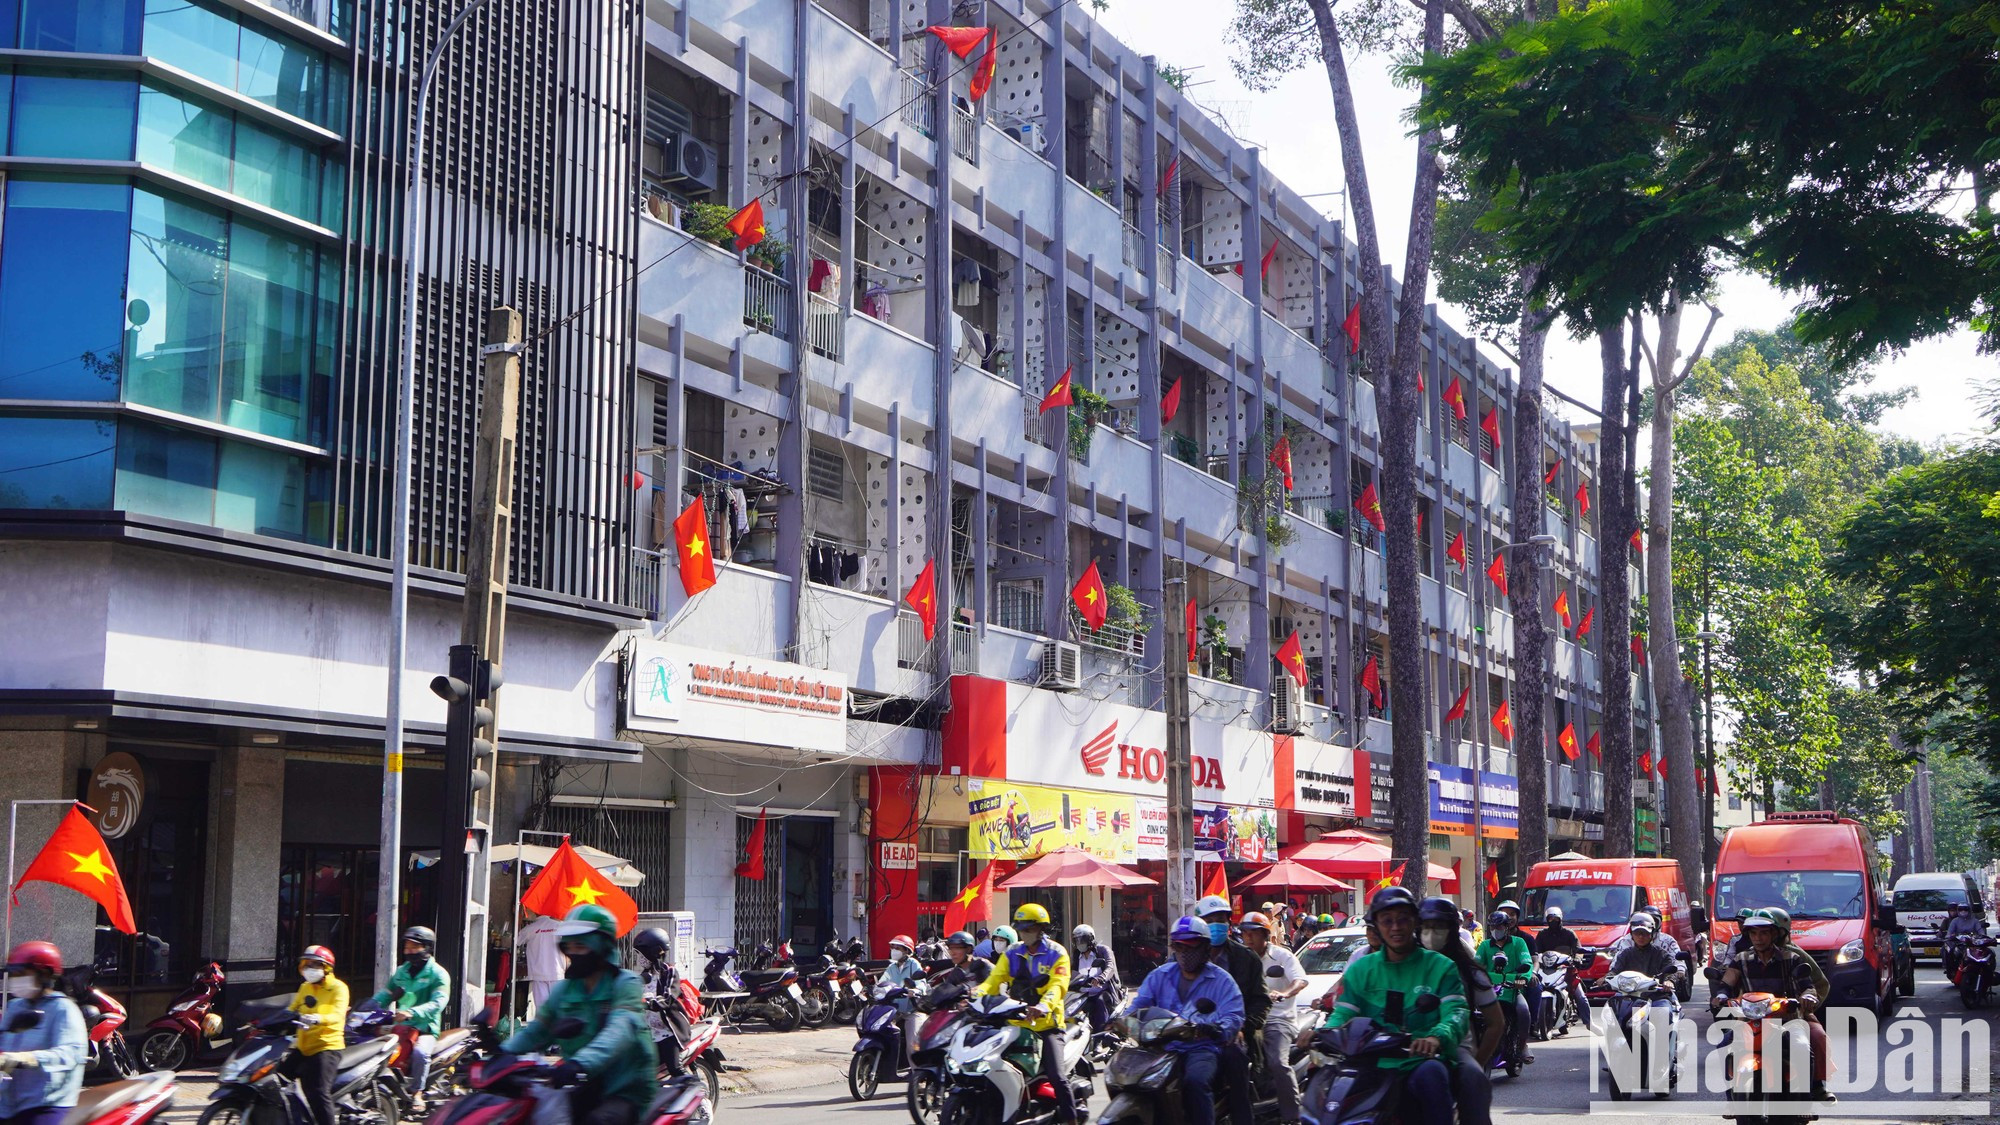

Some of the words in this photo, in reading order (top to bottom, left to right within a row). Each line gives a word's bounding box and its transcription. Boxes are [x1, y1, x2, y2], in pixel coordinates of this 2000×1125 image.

[1117, 743, 1226, 790] HODA
[979, 817, 1003, 837] WAVE
[883, 846, 915, 861] HEAD
[1545, 869, 1613, 882] META.vn
